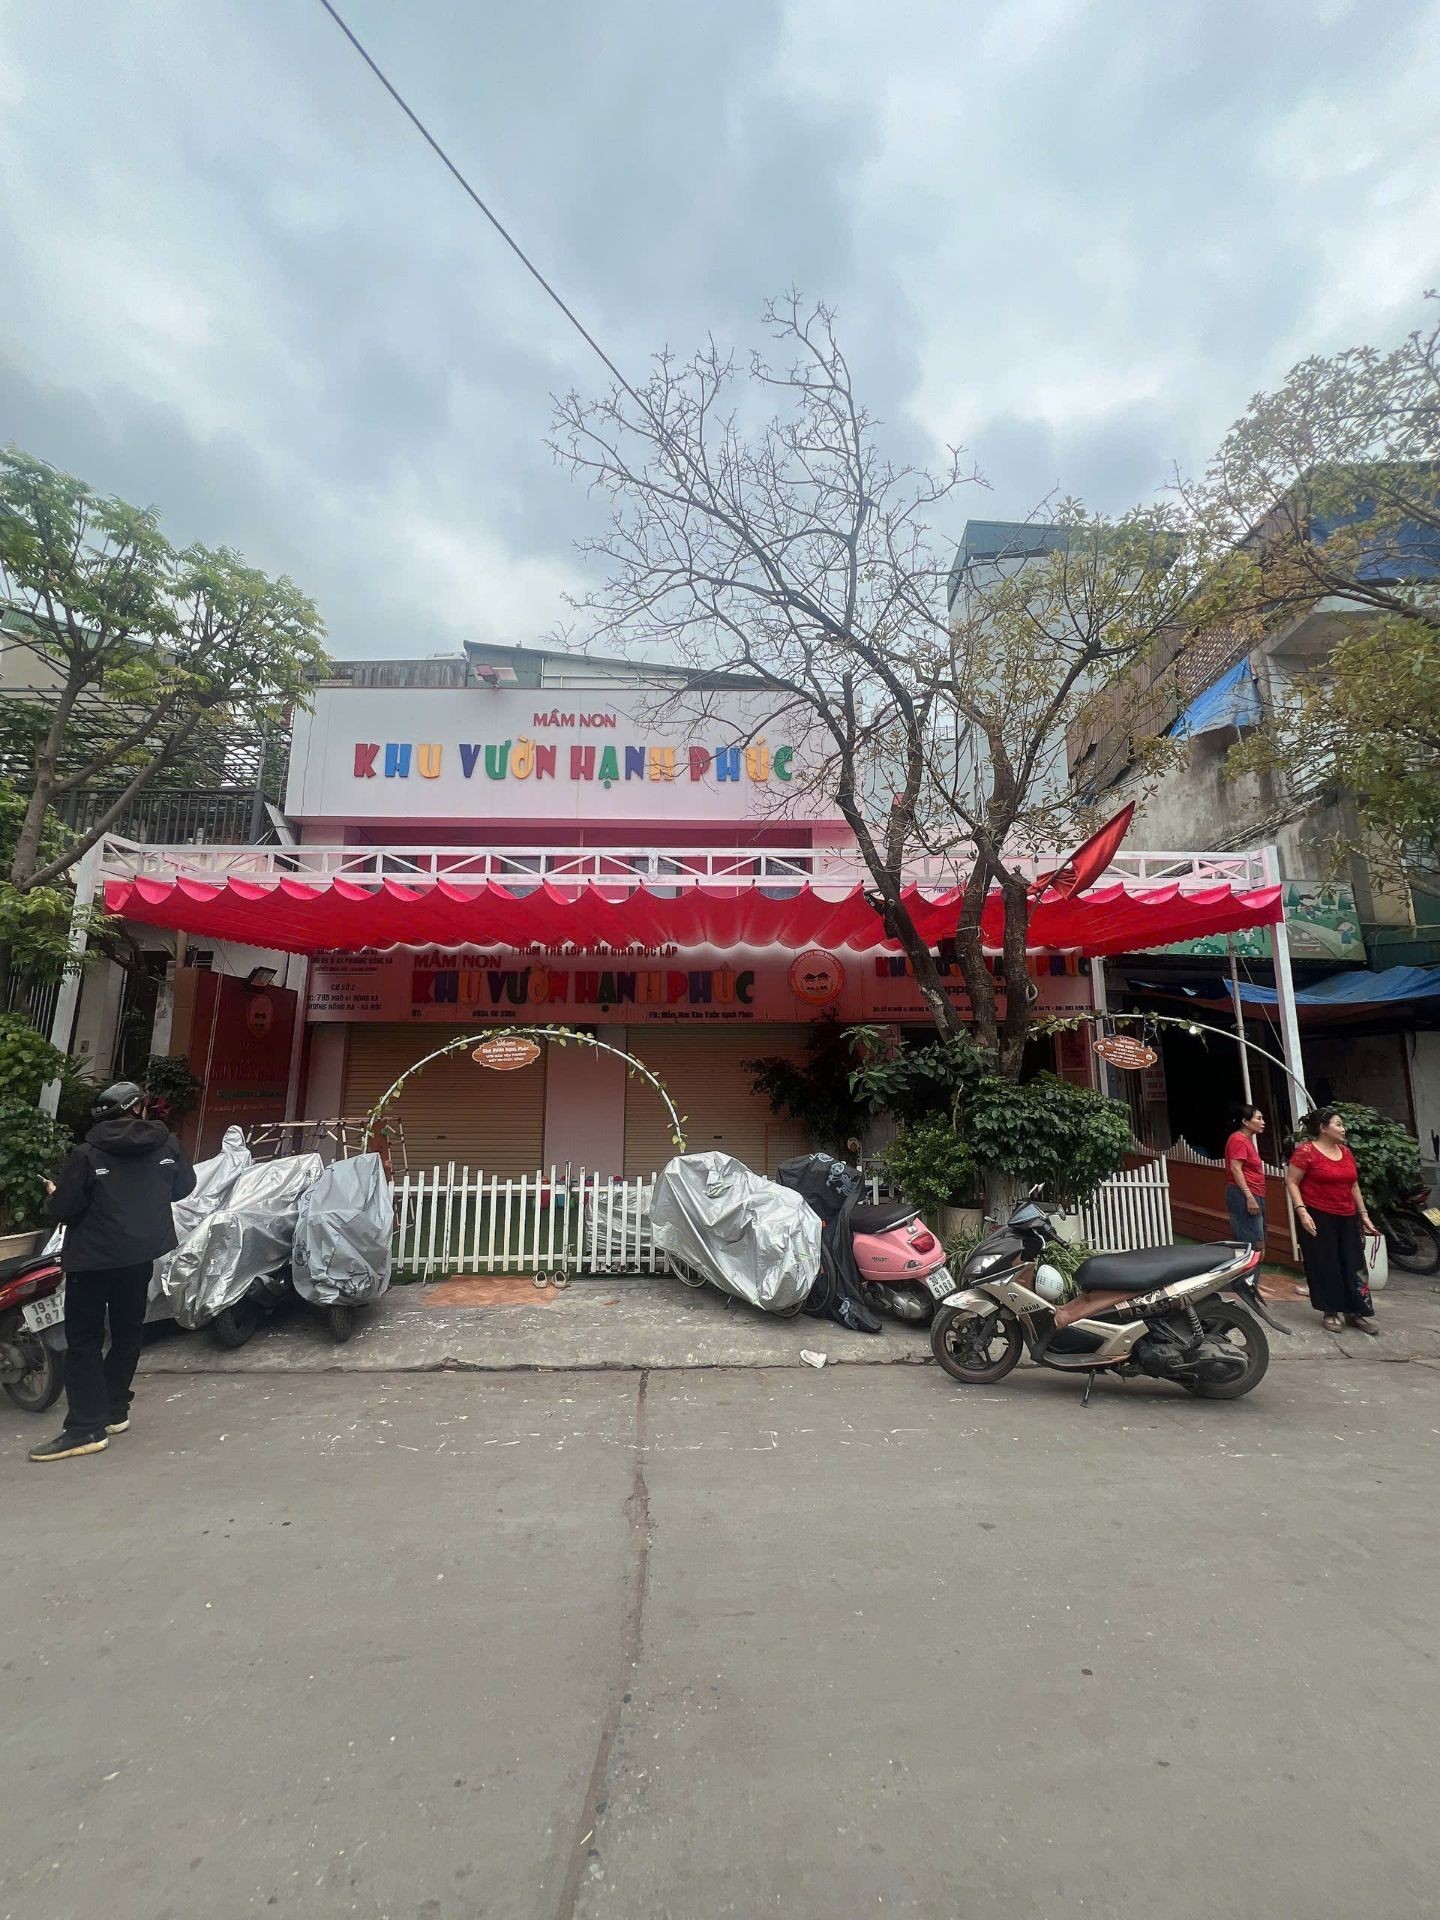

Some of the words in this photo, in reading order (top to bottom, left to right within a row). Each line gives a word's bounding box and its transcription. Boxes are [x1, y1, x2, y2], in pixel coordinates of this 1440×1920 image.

[533, 707, 577, 728] MẦM
[580, 713, 617, 728] NON
[353, 742, 443, 779] KHU
[458, 734, 557, 781] VƯỜN
[569, 743, 677, 789] HẠNH
[688, 734, 794, 782] PHÚC
[462, 954, 502, 968] NON
[412, 970, 482, 1004] KHU
[487, 960, 569, 1004] VƯỜN
[575, 971, 662, 1013] HẠNH
[666, 961, 755, 1004] PHÚC
